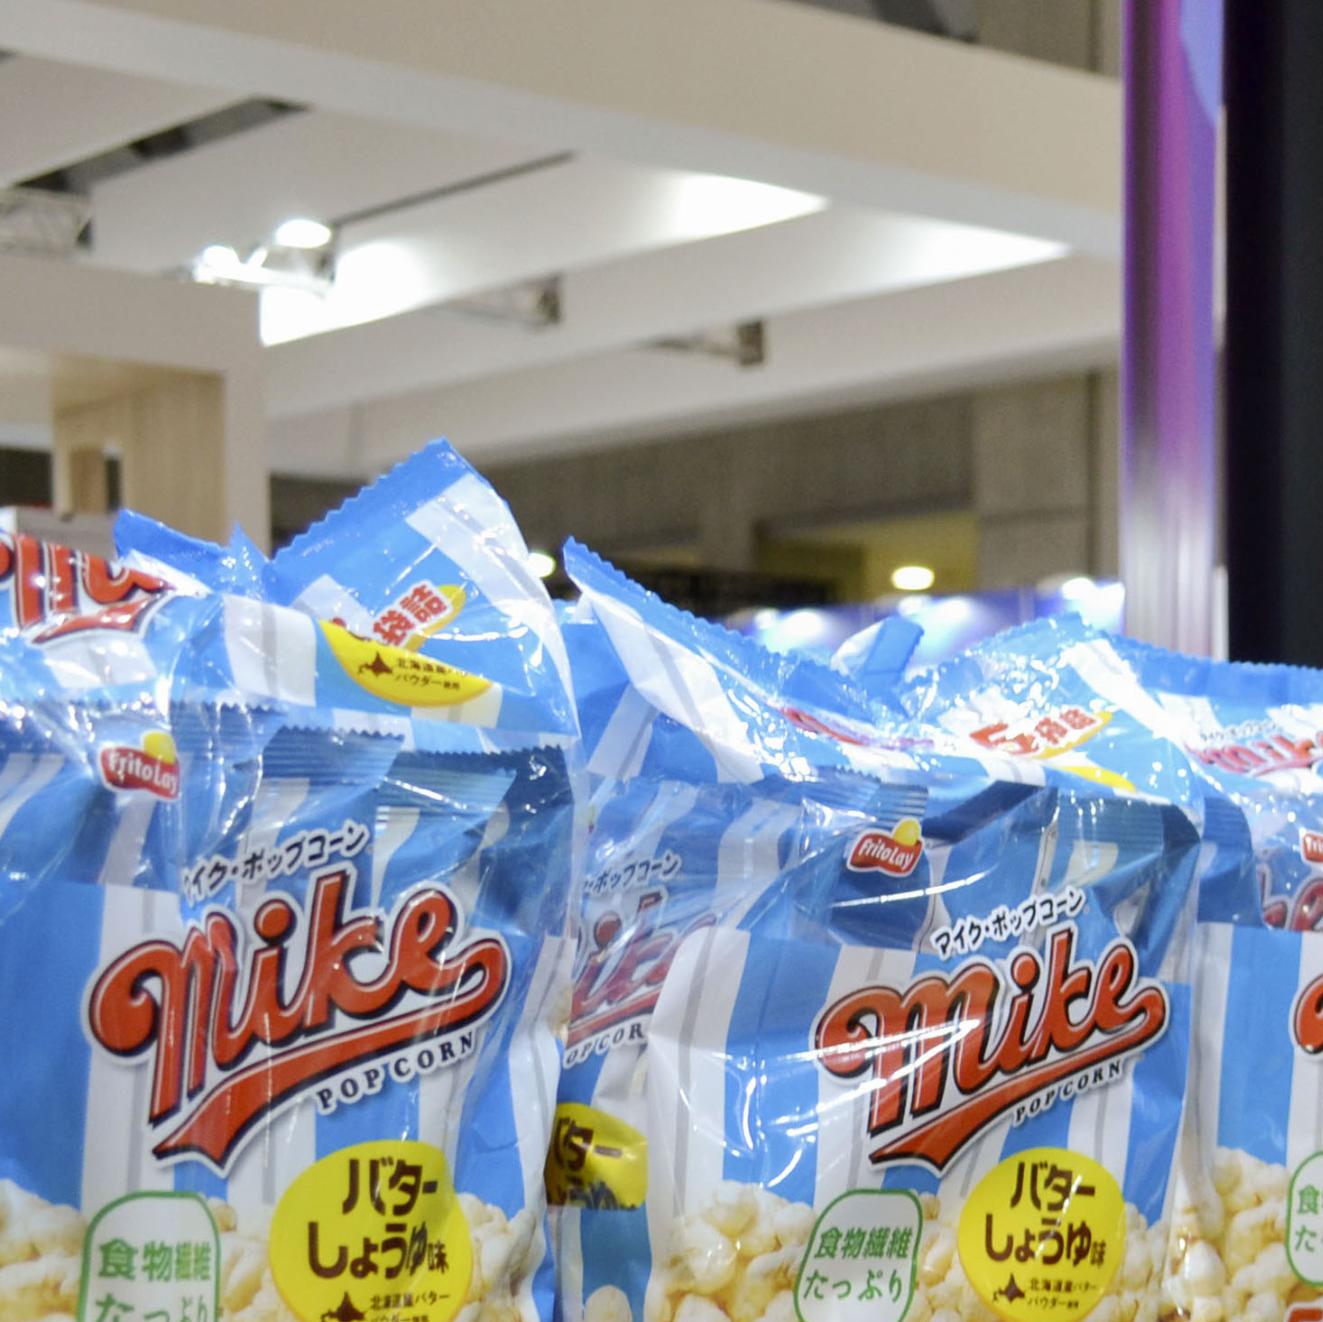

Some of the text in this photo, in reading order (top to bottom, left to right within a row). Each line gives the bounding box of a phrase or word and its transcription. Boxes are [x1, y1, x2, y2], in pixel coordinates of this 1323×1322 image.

[343, 1157, 440, 1217] バター
[1010, 1161, 1096, 1211] バター
[98, 1239, 211, 1283] 食物繊維
[306, 1221, 450, 1280] しょうゆ味
[814, 1227, 912, 1261] 食物繊維
[985, 1213, 1107, 1269] しょうゆ味
[804, 1267, 904, 1304] たっぷり
